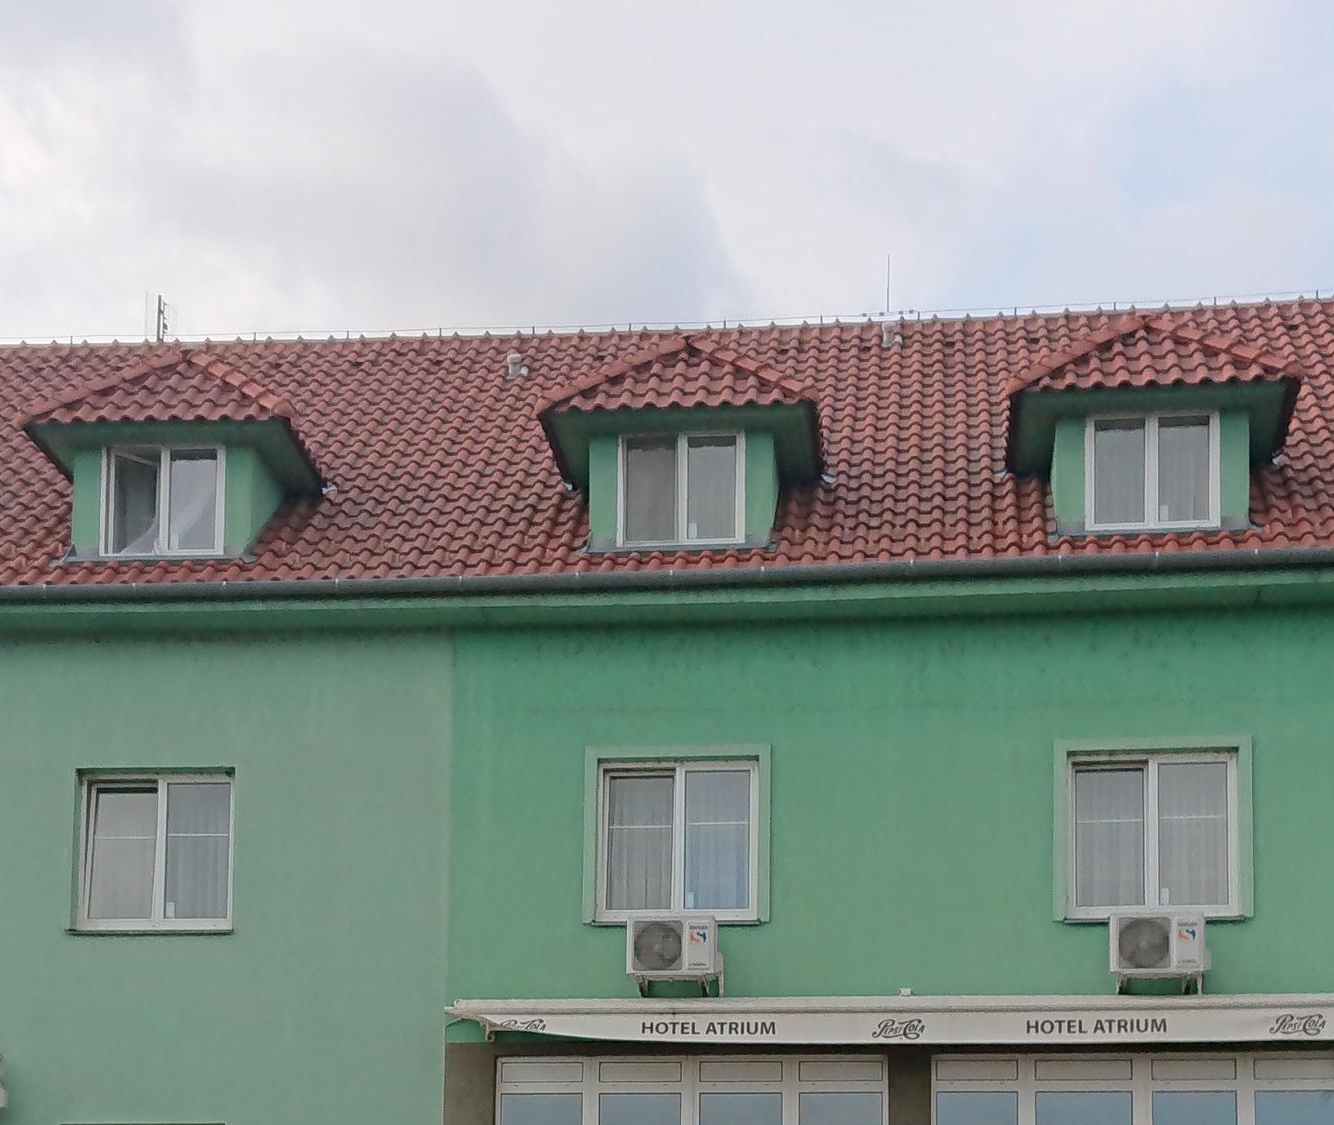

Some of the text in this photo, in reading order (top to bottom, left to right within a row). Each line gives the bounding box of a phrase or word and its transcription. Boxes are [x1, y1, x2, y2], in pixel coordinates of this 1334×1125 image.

[641, 1021, 776, 1035] HOTEL ATRIUM
[1026, 1018, 1167, 1034] HOTEL ATRIUM
